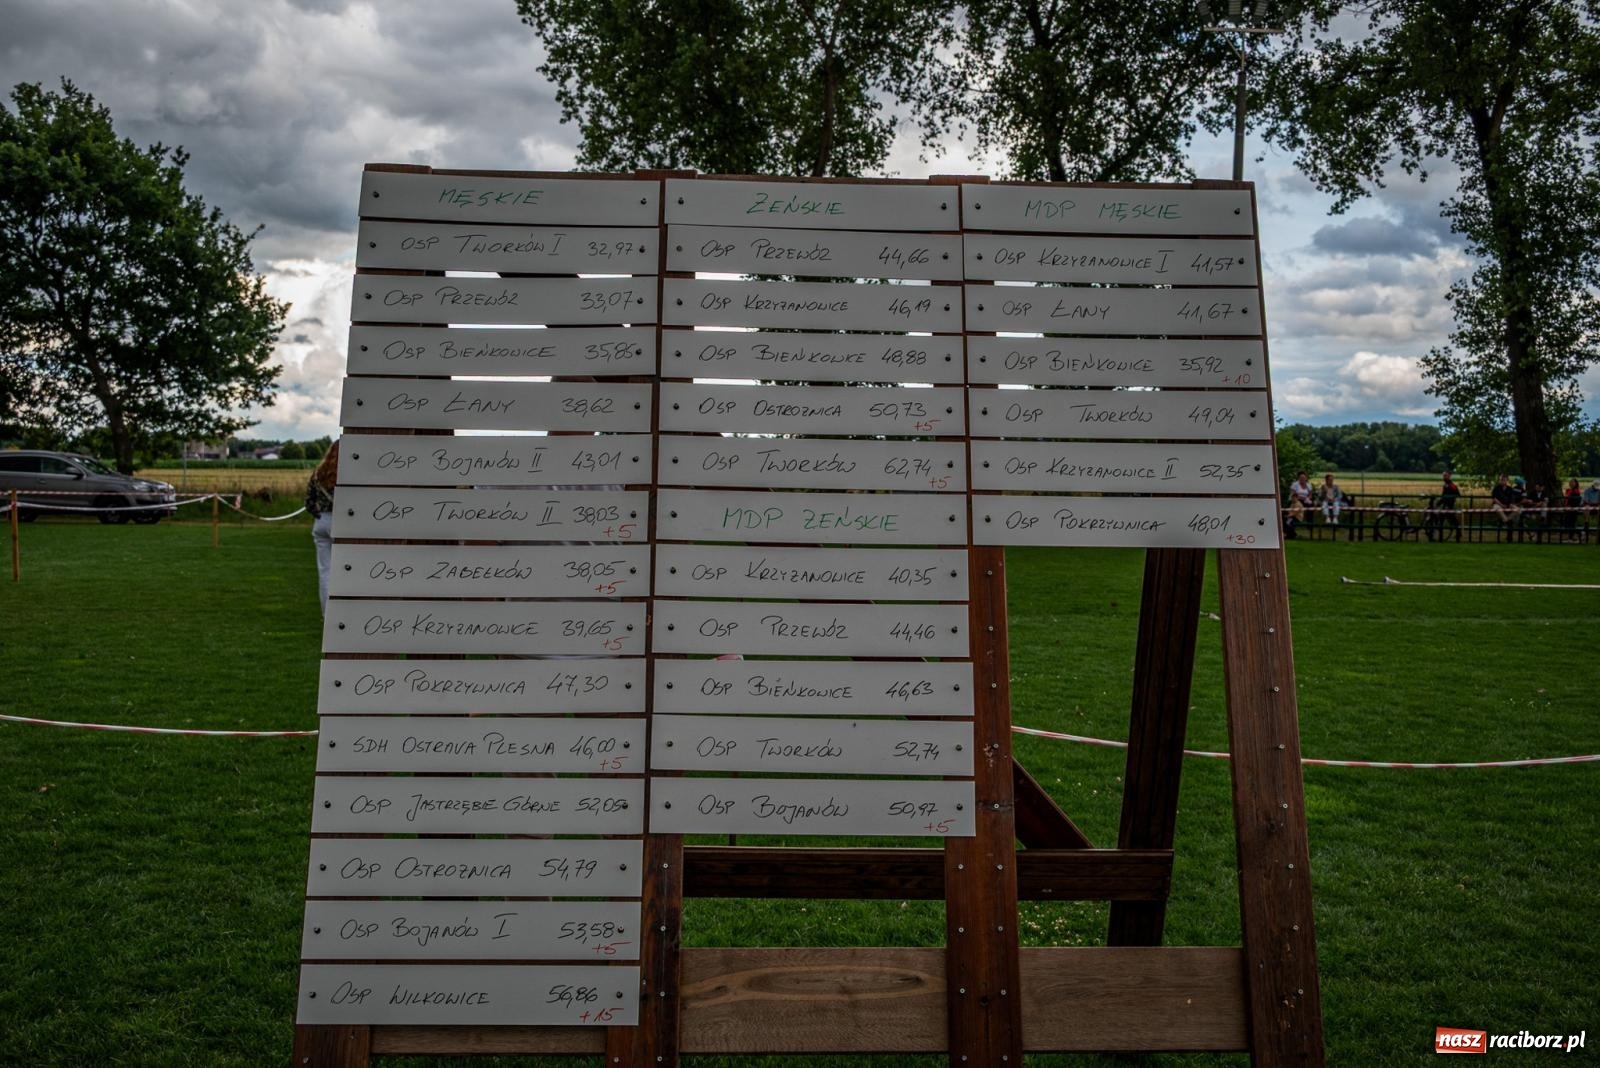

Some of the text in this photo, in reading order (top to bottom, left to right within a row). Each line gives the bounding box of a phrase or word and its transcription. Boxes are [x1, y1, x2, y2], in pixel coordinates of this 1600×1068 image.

[439, 189, 544, 208] MĘSKIE
[1025, 200, 1181, 222] MDP MĘSKIE
[401, 237, 439, 250] OSP
[588, 241, 633, 259] 32,97
[701, 240, 735, 257] OSP
[879, 246, 929, 270] 44,66
[995, 248, 1026, 264] OSP
[1191, 254, 1234, 275] 41,57
[384, 290, 423, 306] OSP
[581, 291, 633, 313] 33,07
[701, 293, 732, 311] OSP
[889, 297, 933, 319] 46,19
[1002, 301, 1032, 316] OSP
[1177, 302, 1235, 323] 41,67
[383, 340, 425, 360] OSP
[699, 345, 736, 361] OSP
[882, 348, 926, 367] 48,88
[1005, 351, 1038, 370] OSP
[1179, 354, 1224, 375] 35,92
[388, 393, 429, 411] OSP
[562, 398, 615, 418] 38,62
[699, 397, 736, 415] OSP
[869, 402, 926, 420] 50,73
[1006, 403, 1043, 422] OSP
[1188, 406, 1235, 428] 49,04
[377, 451, 417, 468] OSP
[569, 448, 623, 472] 43,01
[703, 452, 739, 470] OSP
[884, 456, 935, 478] 62,74
[1005, 457, 1037, 474] OSP
[1200, 464, 1253, 481] 52,35
[373, 501, 414, 520] OSP
[573, 504, 622, 528] 38,03
[722, 507, 783, 529] MDP
[1006, 509, 1232, 536] OSP POKRZYWNICA 48,01
[370, 561, 413, 580] OSP
[563, 560, 627, 585] 38,05
[692, 564, 727, 580] OSP
[888, 567, 937, 586] 40,35
[364, 616, 402, 636] OSP
[561, 620, 618, 639] 39,65
[699, 618, 739, 638] OSP
[889, 622, 936, 643] 44,46
[354, 667, 608, 696] OSP POKRZYWNICA 47,30
[700, 678, 732, 695] OSP
[885, 680, 936, 702] 46,63
[353, 736, 388, 753] SDH
[569, 736, 618, 762] 46,00
[697, 736, 737, 757] OSP
[893, 741, 939, 761] 52,74
[350, 795, 391, 815] OSP
[698, 794, 735, 815] OSP
[888, 801, 938, 819] 50,97
[341, 858, 381, 879] OSP
[538, 858, 599, 881] 54,79
[340, 919, 379, 940] OSP
[557, 922, 615, 945] 53,58
[330, 981, 598, 1008] OSP WILKOWICE 56,86
